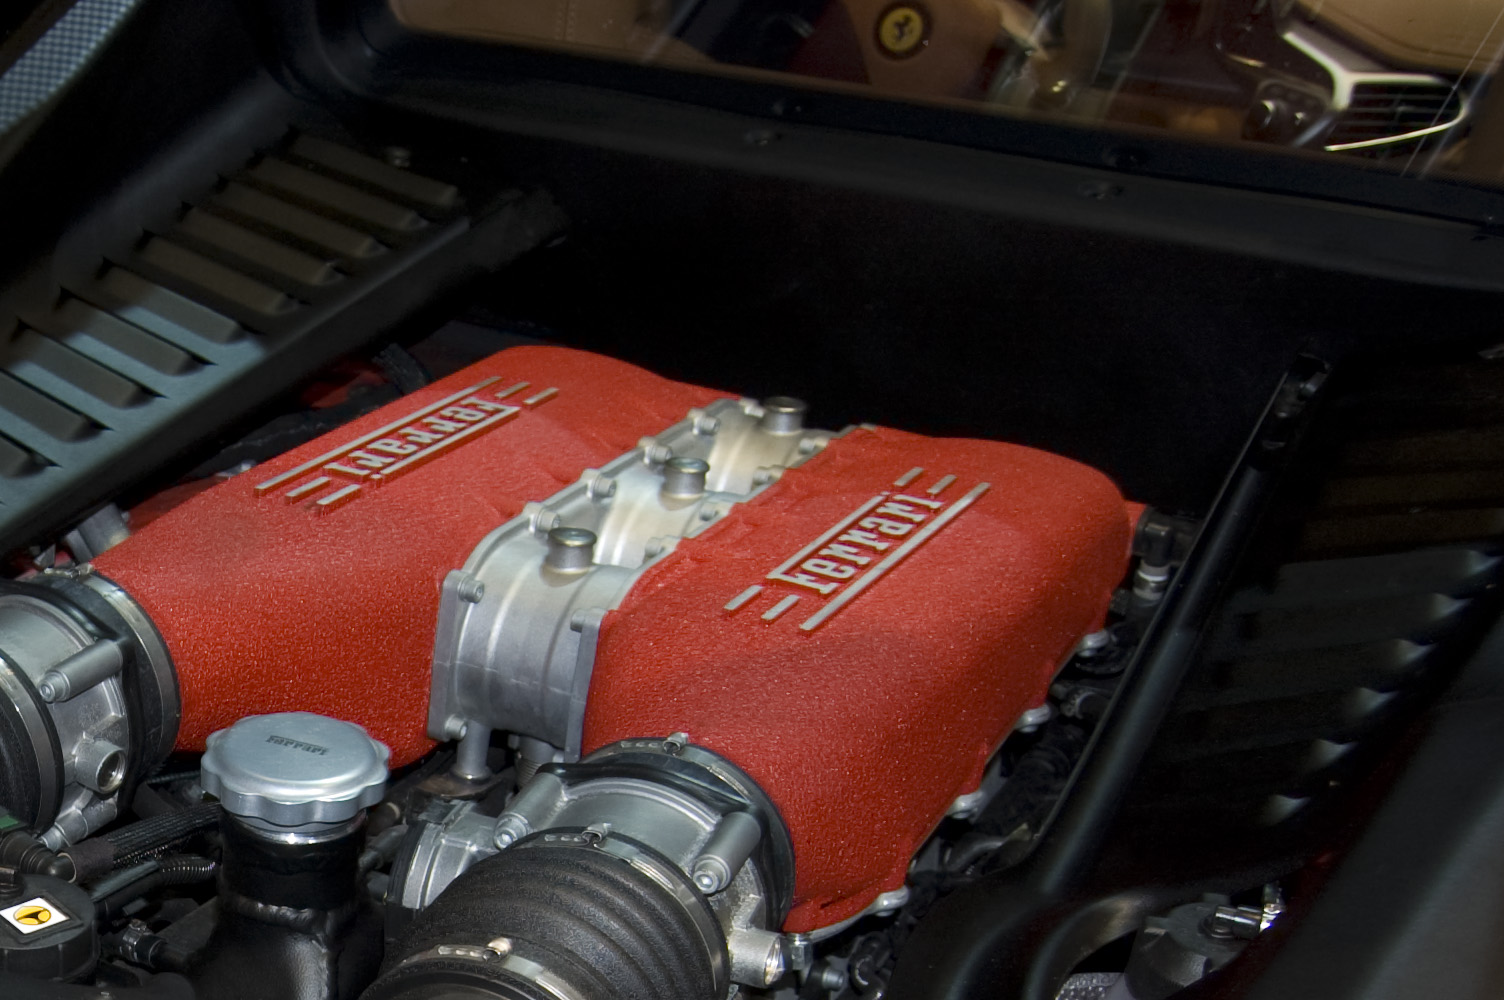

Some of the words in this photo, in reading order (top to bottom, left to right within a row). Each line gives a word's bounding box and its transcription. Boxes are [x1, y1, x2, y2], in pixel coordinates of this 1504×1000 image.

[322, 395, 522, 481] Ferrari
[764, 491, 944, 595] Ferrari
[264, 734, 330, 756] Ferrari
